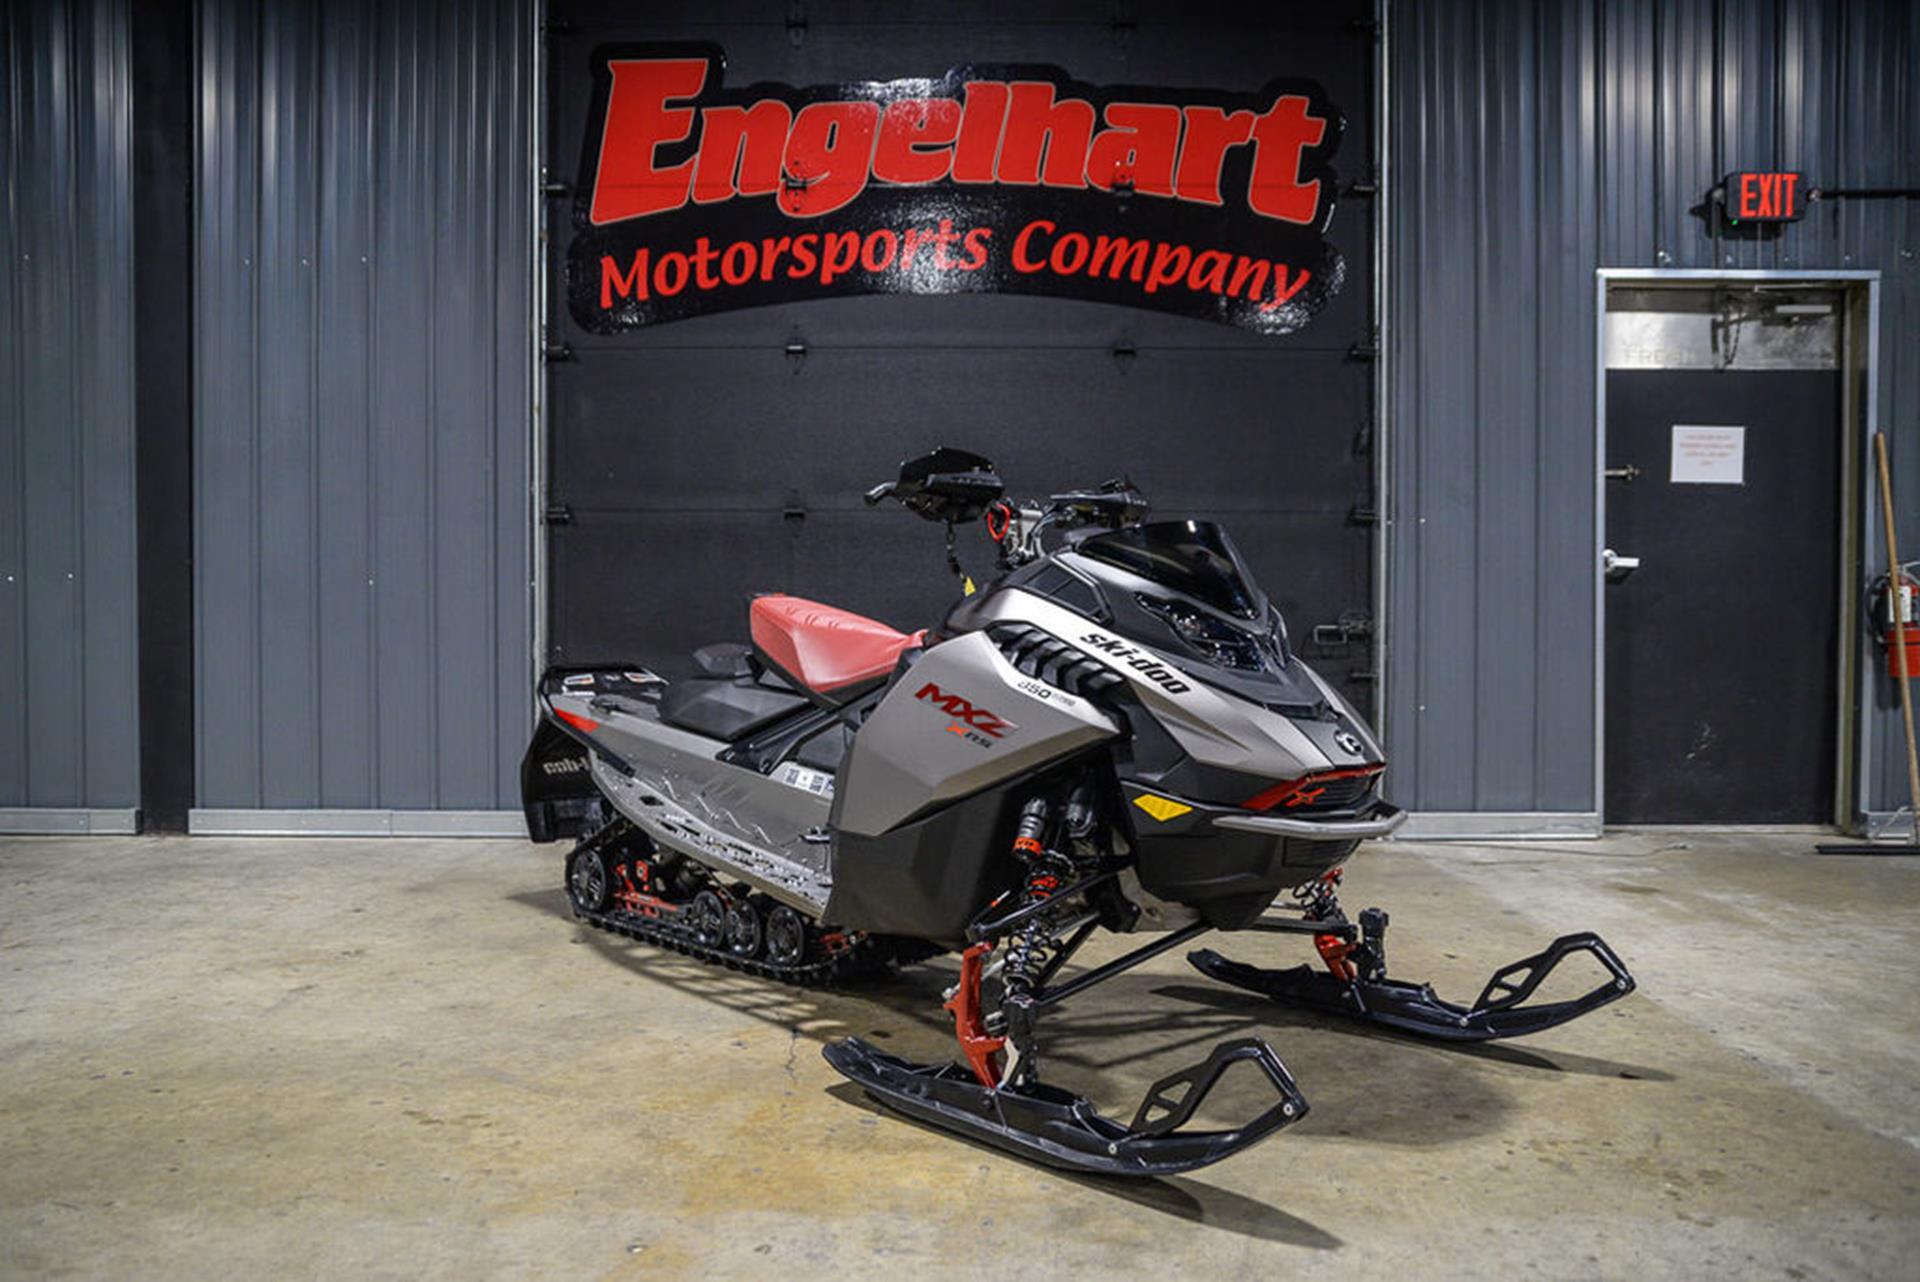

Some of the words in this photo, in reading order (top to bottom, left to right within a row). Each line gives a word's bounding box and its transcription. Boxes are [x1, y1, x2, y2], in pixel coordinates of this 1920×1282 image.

[591, 58, 1327, 225] Engelhart
[1740, 173, 1798, 218] EXIT
[599, 217, 992, 309] Motorsports
[1011, 219, 1311, 312] Company
[915, 682, 1020, 739] MXZ
